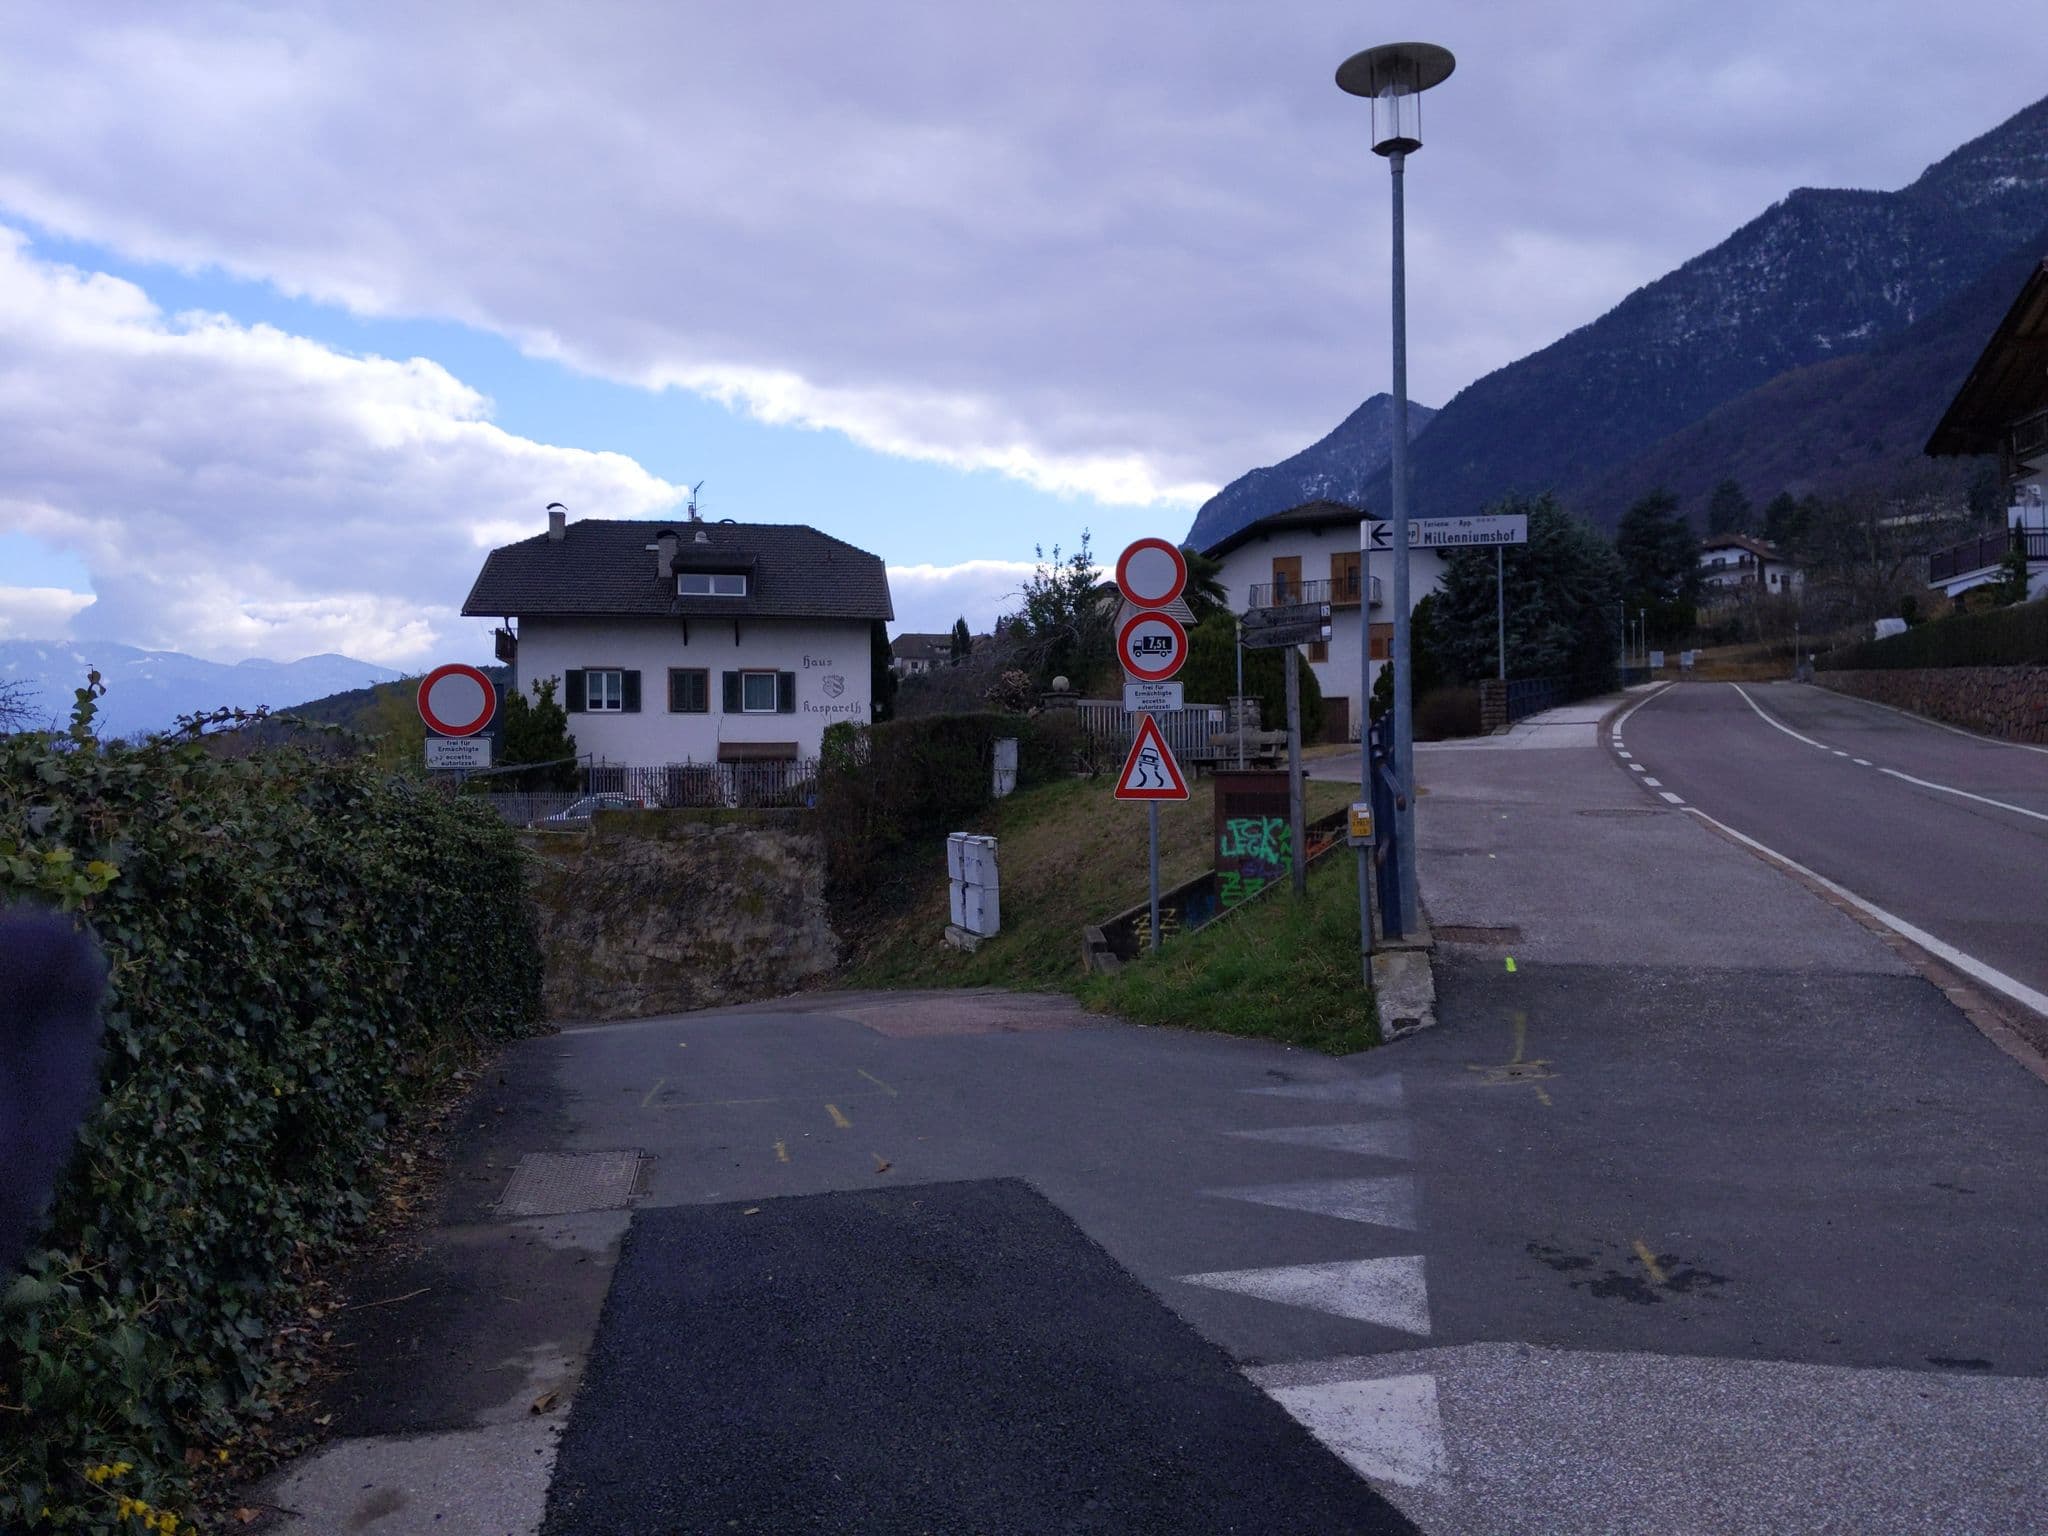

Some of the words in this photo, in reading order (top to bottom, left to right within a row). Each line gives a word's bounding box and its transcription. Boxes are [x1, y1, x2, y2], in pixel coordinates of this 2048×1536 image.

[1424, 529, 1515, 545] Millenniumshof
[1149, 637, 1166, 650] 7,5t
[801, 654, 833, 669] Haus
